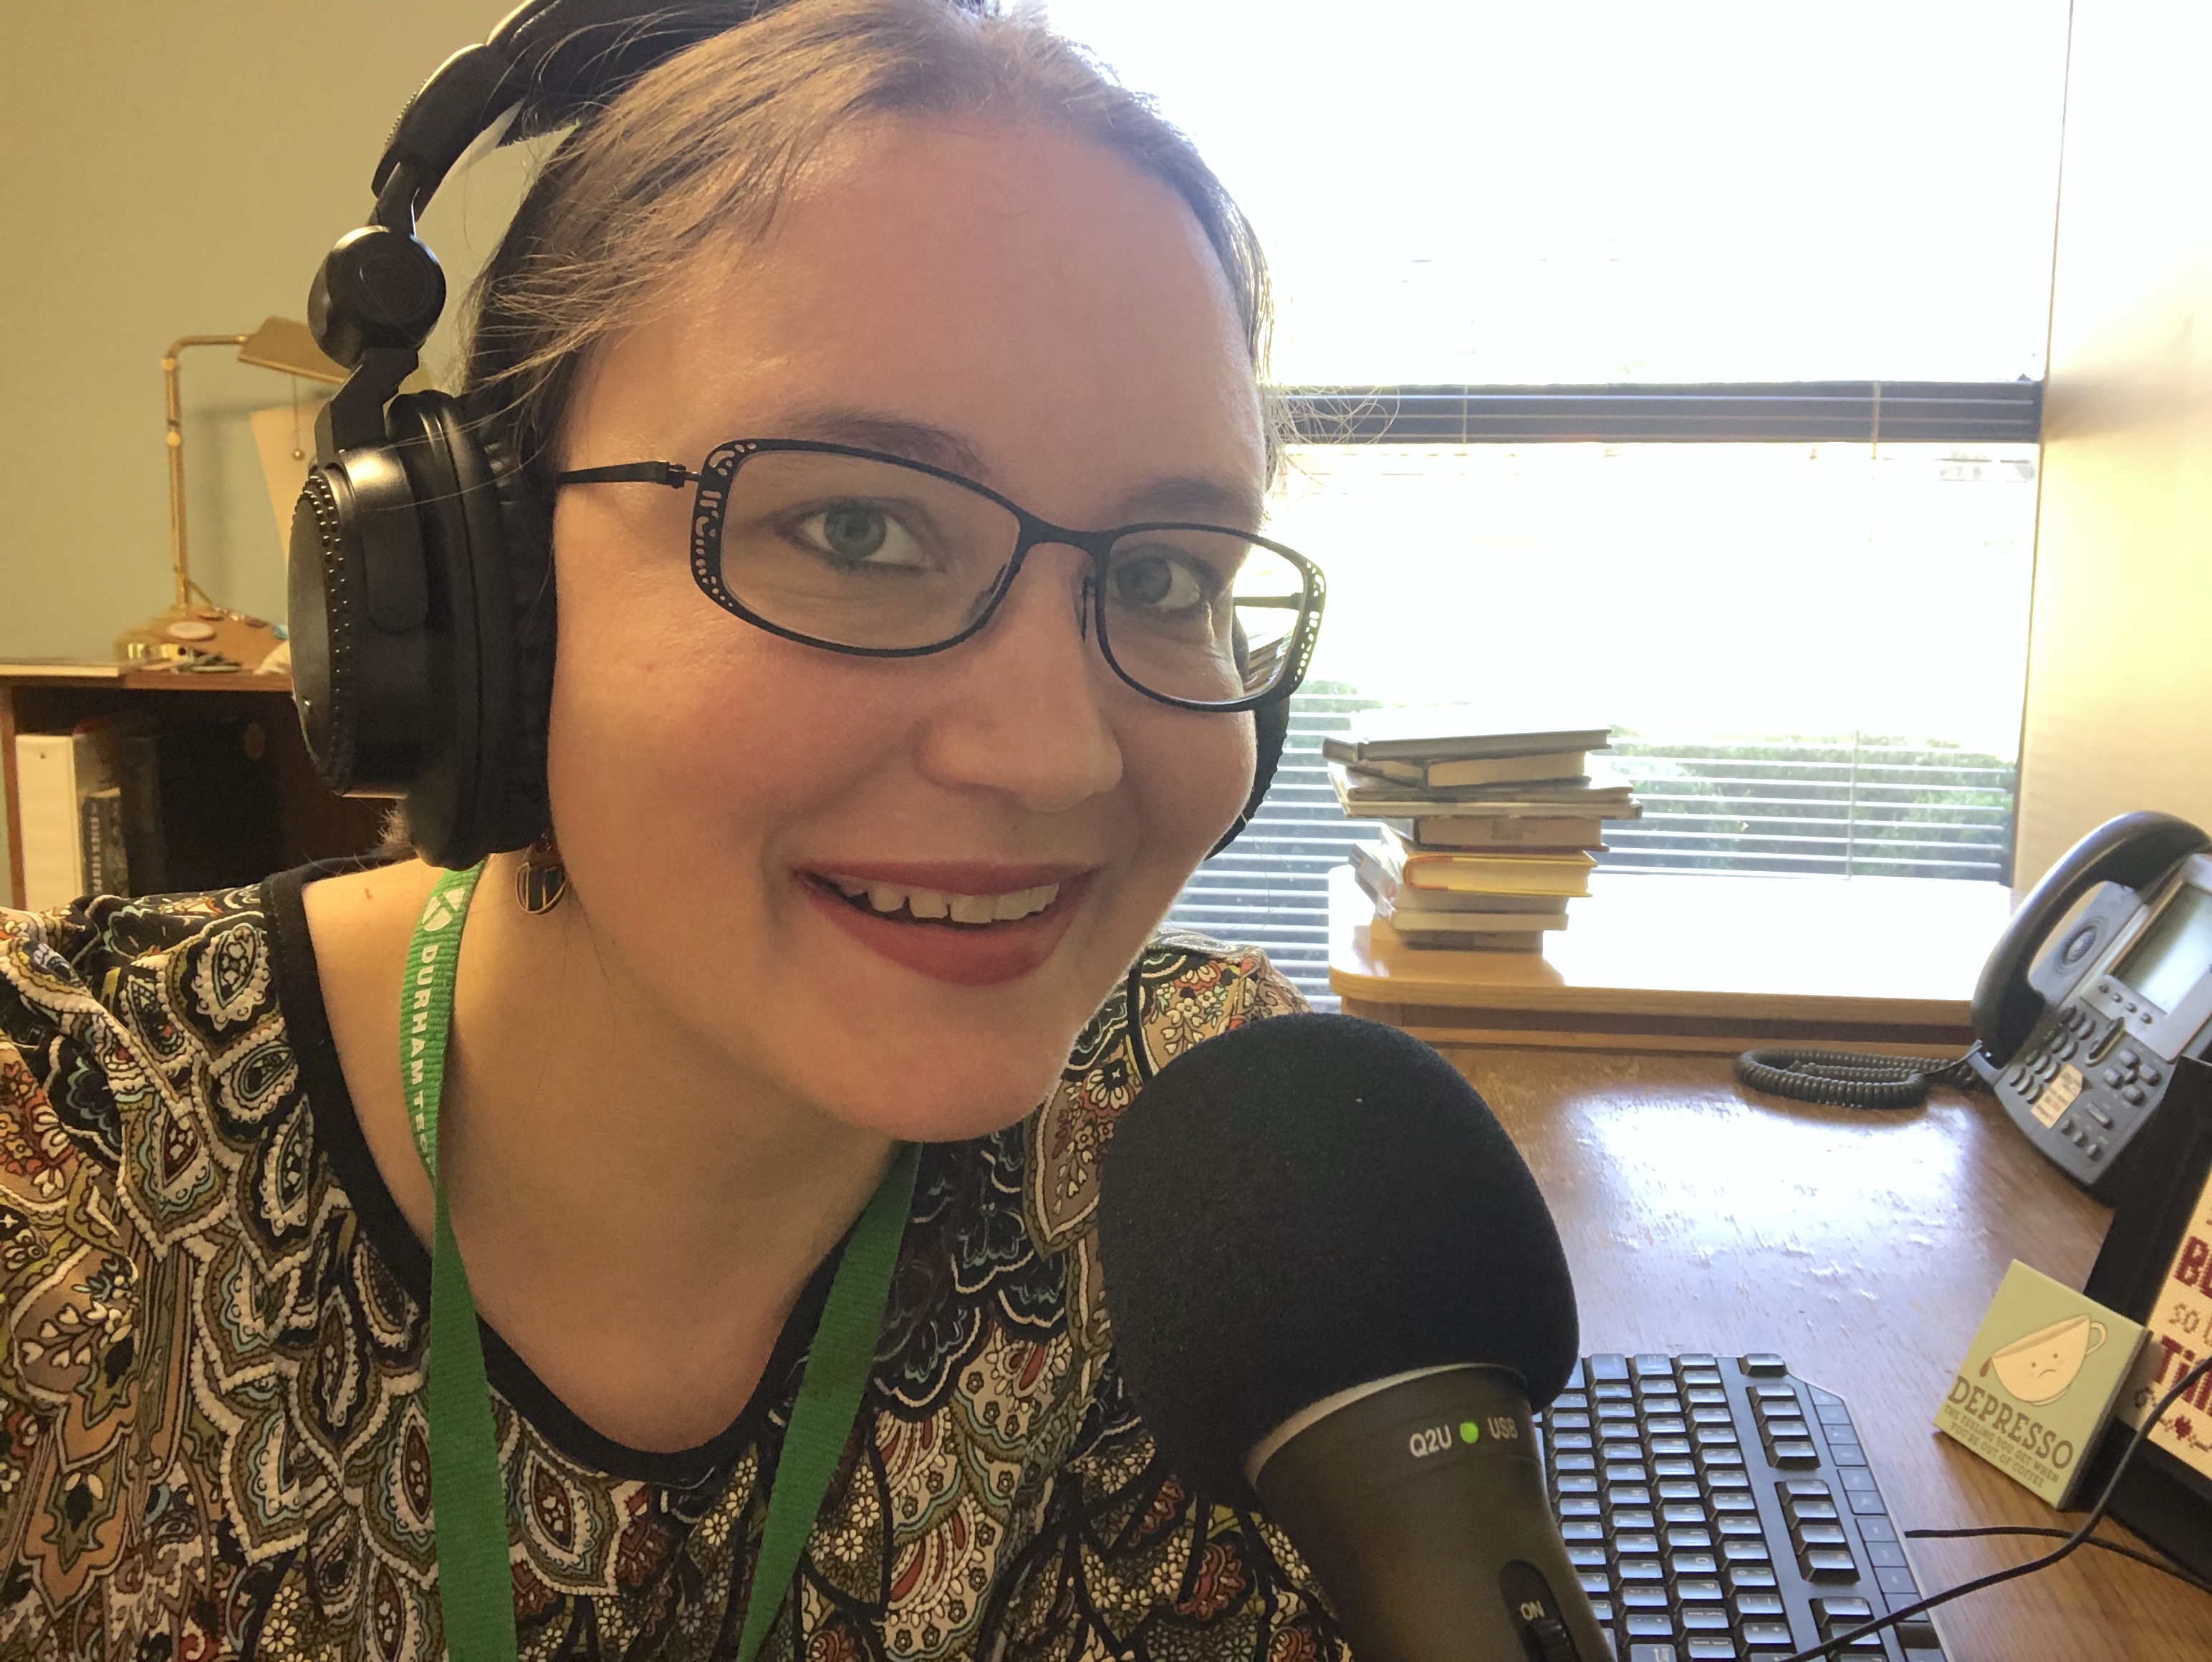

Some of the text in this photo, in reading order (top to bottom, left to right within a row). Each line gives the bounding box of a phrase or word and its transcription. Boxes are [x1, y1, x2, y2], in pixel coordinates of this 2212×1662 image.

[411, 944, 439, 1085] DURHAM
[2168, 1302, 2200, 1334] SO
[1409, 1417, 1518, 1458] Q2U USB
[1944, 1404, 2060, 1484] THE FEELING YOU GET WHEN
[1948, 1375, 2074, 1469] DEPRESSO
[1981, 1442, 1999, 1458] OUT
[1999, 1454, 2012, 1466] OF
[2013, 1461, 2045, 1488] COFFEE
[1520, 1600, 1545, 1621] ON
